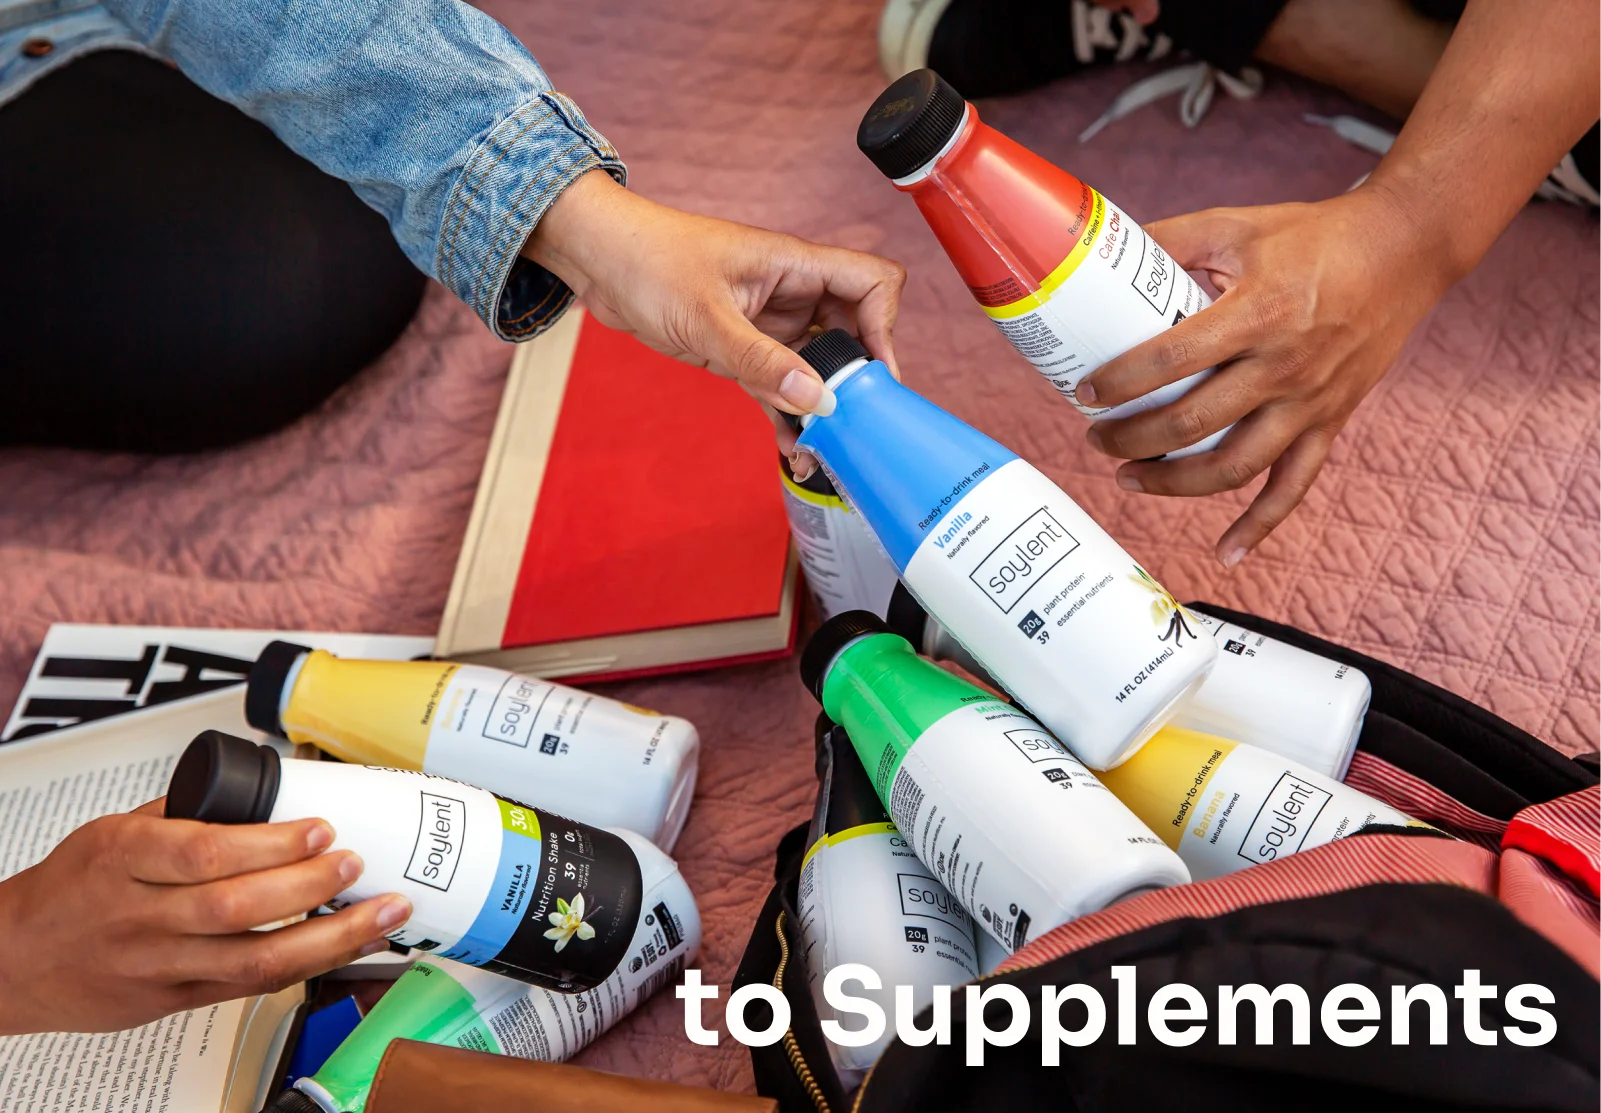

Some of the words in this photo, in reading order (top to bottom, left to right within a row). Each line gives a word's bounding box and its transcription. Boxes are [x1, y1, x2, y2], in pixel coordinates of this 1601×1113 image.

[1098, 233, 1117, 260] Cafe
[1109, 208, 1121, 232] Chai
[918, 477, 973, 531] Ready-to-drink
[972, 462, 990, 478] meal
[934, 510, 973, 550] Vanilla
[947, 532, 970, 560] Naturally
[967, 515, 990, 538] flavored
[989, 522, 1062, 594] soylent
[1023, 616, 1042, 634] 20g
[1044, 595, 1062, 615] plant
[1036, 630, 1050, 645] 39
[1056, 597, 1087, 627] essential
[1116, 692, 1127, 703] 14
[1124, 683, 1137, 694] FL
[1134, 671, 1148, 685] OZ
[1144, 647, 1174, 674] (414mL)
[500, 678, 540, 736] soylent
[560, 743, 570, 754] 39
[1048, 771, 1068, 780] 20g
[1059, 782, 1073, 790] 39
[1172, 764, 1212, 827] Ready-to-drink
[1208, 750, 1222, 766] meal
[1193, 790, 1226, 838] Banana
[1210, 814, 1228, 845] Naturally
[1223, 792, 1240, 818] flavored
[1258, 783, 1314, 861] soylent
[423, 800, 452, 880] soylent
[532, 866, 557, 922] Nutrition
[549, 832, 558, 864] Shake
[565, 862, 576, 880] 39
[501, 864, 524, 912] VANILLA
[512, 888, 526, 915] Naturally
[521, 864, 532, 891] flavored
[908, 930, 927, 942] 20g
[934, 935, 952, 948] plant
[912, 944, 926, 954] 39
[164, 1026, 174, 1044] made
[203, 1023, 212, 1037] Time
[81, 1049, 90, 1059] the
[120, 1036, 131, 1054] years
[133, 1041, 144, 1058] with
[147, 1038, 157, 1054] with
[52, 1052, 62, 1065] you
[103, 1054, 112, 1067] way
[114, 1055, 127, 1076] older)
[128, 1058, 137, 1069] my
[144, 1053, 153, 1065] his
[154, 1049, 167, 1076] fortune
[172, 1054, 179, 1062] he
[36, 1060, 48, 1078] have
[45, 1065, 60, 1089] should
[75, 1059, 86, 1078] Lord
[87, 1060, 99, 1078] above
[99, 1069, 109, 1084] that
[164, 1062, 178, 1085] (along
[27, 1078, 42, 1100] always
[72, 1079, 80, 1087] of
[81, 1079, 92, 1093] you
[111, 1076, 120, 1088] and
[122, 1070, 135, 1094] father.
[132, 1066, 150, 1102] stepfather,
[152, 1076, 159, 1084] in
[53, 1092, 64, 1106] and
[68, 1086, 78, 1098] the
[149, 1084, 157, 1098] real
[161, 1086, 171, 1103] with
[79, 1094, 89, 1109] and
[91, 1091, 103, 1111] could
[104, 1094, 116, 1113] could
[119, 1093, 129, 1108] We
